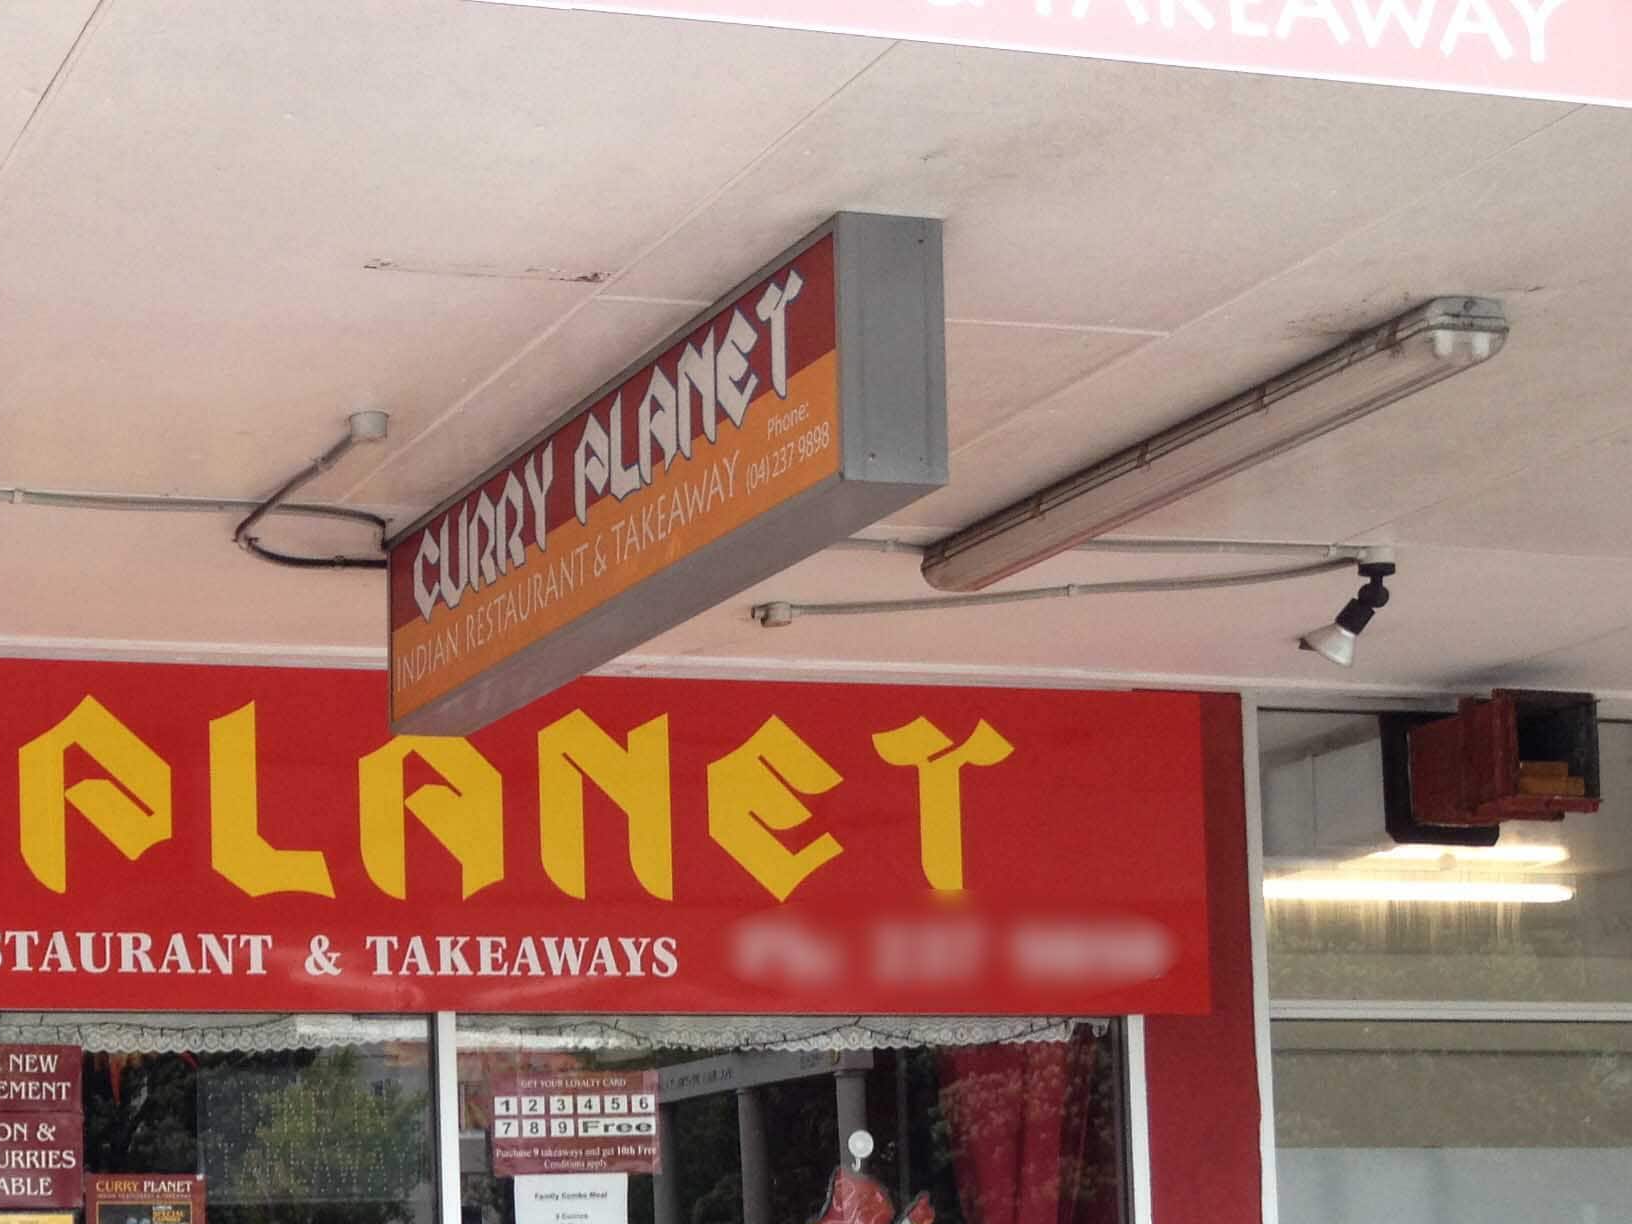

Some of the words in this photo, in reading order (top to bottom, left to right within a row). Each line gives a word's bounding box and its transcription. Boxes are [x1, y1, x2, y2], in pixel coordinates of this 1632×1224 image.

[767, 401, 809, 441] Phone:
[413, 441, 553, 624] CURRY
[574, 269, 804, 525] PLANET
[746, 454, 770, 496] (04)
[771, 442, 795, 479] 237
[797, 421, 831, 463] 9898
[396, 629, 460, 692] INDIAN
[465, 542, 589, 653] RESTAURANT
[593, 537, 609, 578] &
[611, 449, 741, 566] TAKEAWAY
[20, 696, 1014, 903] PLANET
[304, 934, 341, 977] &
[366, 936, 678, 977] TAKEAWAYS
[9, 1053, 58, 1073] NEW
[521, 1080, 537, 1089] GET
[540, 1080, 563, 1089] YOUR
[565, 1079, 600, 1089] LOYALTY
[602, 1079, 626, 1088] CARD
[500, 1100, 511, 1113] 1
[528, 1099, 538, 1112] 2
[556, 1099, 566, 1112] 3
[584, 1098, 593, 1111] 4
[611, 1098, 620, 1110] 5
[639, 1097, 649, 1110] 6
[36, 1122, 57, 1142] &
[502, 1122, 512, 1135] 7
[529, 1122, 539, 1134] 8
[558, 1121, 567, 1134] 9
[582, 1120, 652, 1134] Free
[638, 1145, 657, 1156] Free
[96, 1181, 139, 1193] CURRY
[143, 1180, 193, 1193] PLANET
